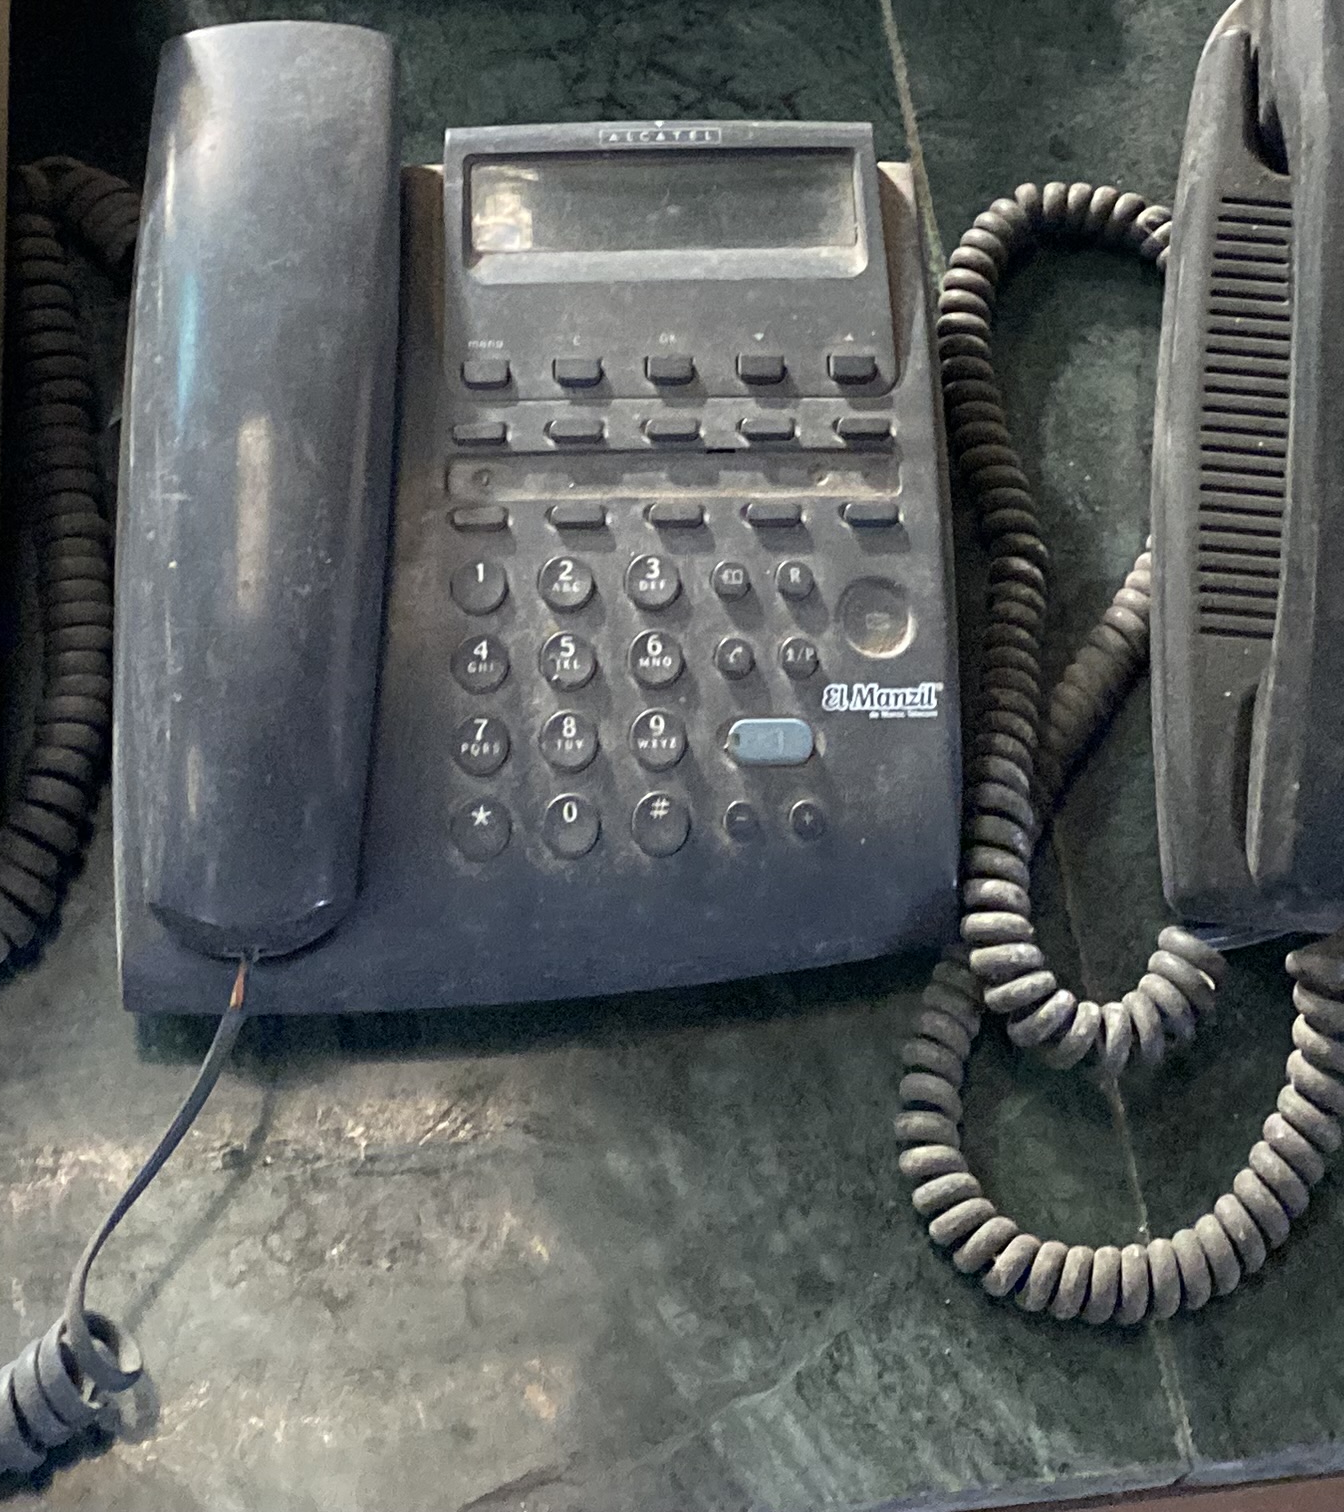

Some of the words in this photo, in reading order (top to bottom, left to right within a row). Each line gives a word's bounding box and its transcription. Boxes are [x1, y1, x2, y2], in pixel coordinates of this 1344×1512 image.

[608, 130, 712, 142] ALCATEL
[476, 563, 484, 582] 1
[559, 562, 573, 580] 2
[646, 559, 660, 578] 3
[474, 640, 488, 659] 4
[560, 639, 575, 657] 5
[647, 636, 662, 656] 6
[822, 683, 848, 711] El
[849, 682, 937, 711] Manzil
[474, 718, 488, 740] 7
[563, 717, 576, 737] 8
[650, 715, 665, 736] 9
[563, 802, 578, 822] 0
